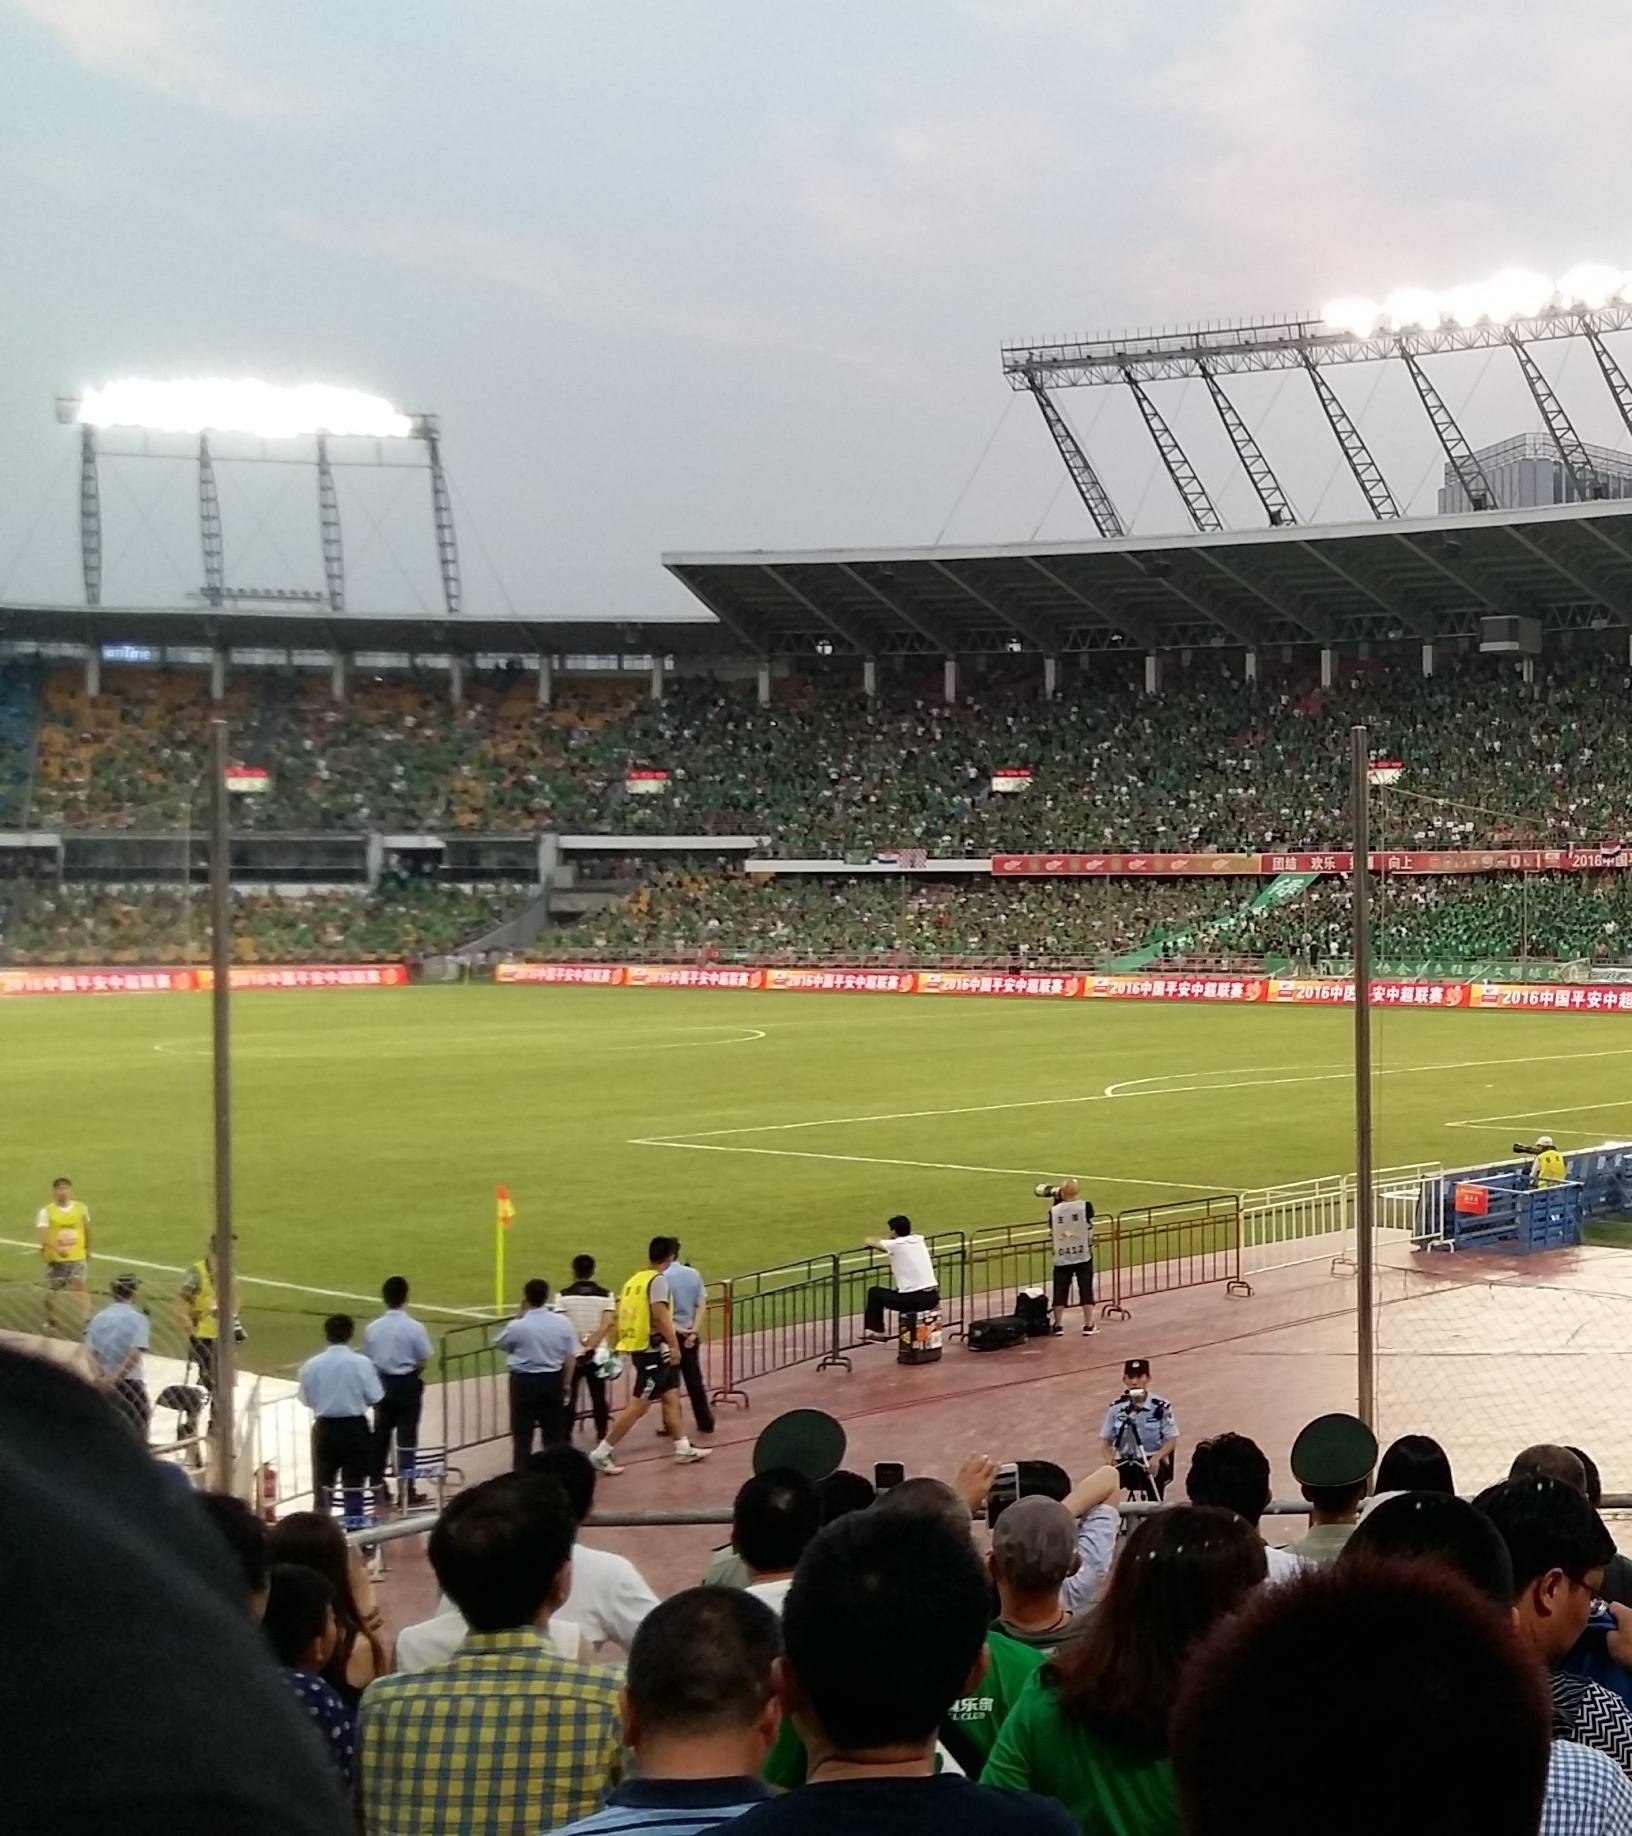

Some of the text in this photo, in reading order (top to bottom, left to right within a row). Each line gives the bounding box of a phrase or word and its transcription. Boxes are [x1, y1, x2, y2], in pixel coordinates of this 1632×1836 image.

[1272, 857, 1297, 870] 团结
[1311, 856, 1336, 870] 欢乐
[1388, 856, 1413, 870] 向上
[941, 977, 1063, 994] 2016中国平安中超联赛
[1110, 981, 1243, 998] 2016中国平安中超联赛
[1297, 985, 1444, 1003] 2016中国安中超联赛
[1058, 1244, 1085, 1256] 0412
